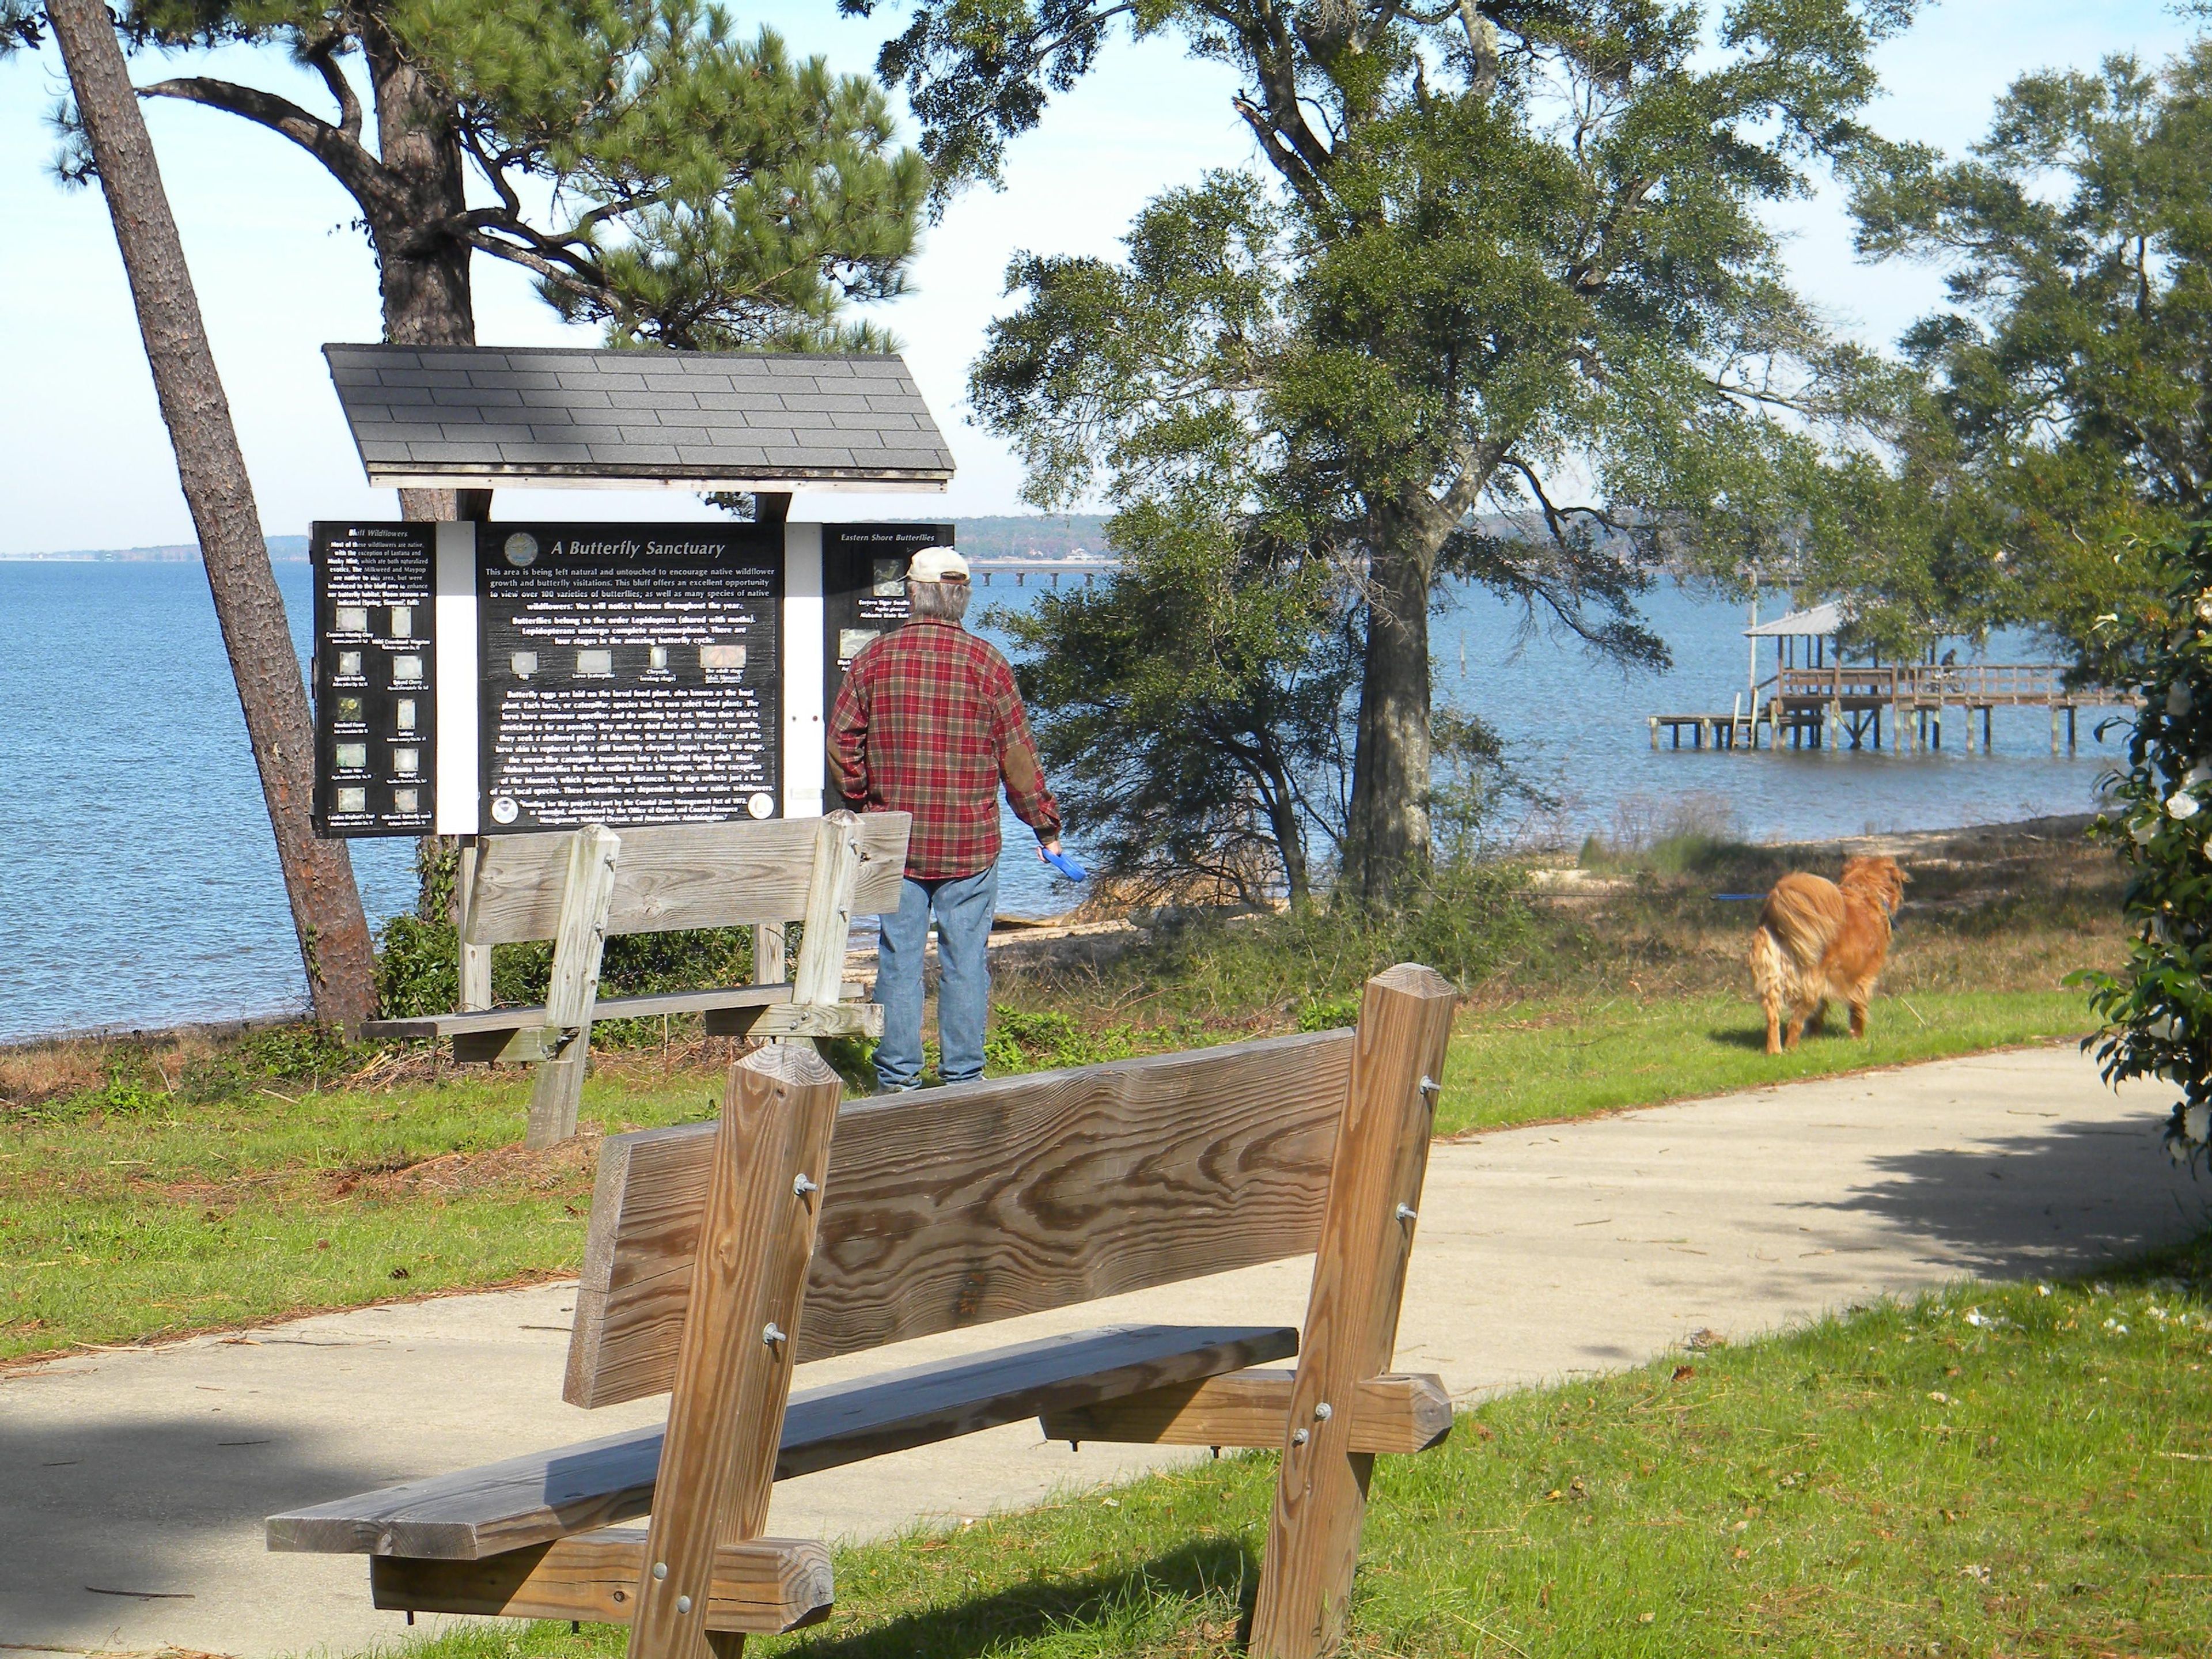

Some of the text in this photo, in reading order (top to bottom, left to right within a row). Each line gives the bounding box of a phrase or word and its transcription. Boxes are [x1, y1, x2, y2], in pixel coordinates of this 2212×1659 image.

[551, 541, 562, 554] A
[569, 540, 640, 558] Butterfly
[646, 541, 725, 558] Sanctuary
[532, 568, 552, 577] being
[490, 579, 517, 588] growth
[537, 579, 570, 588] butterfly
[725, 578, 769, 587] opportunity
[601, 590, 642, 598] butterflies;
[512, 616, 551, 624] Butterflies
[554, 616, 580, 626] belong
[593, 616, 605, 624] the
[631, 616, 676, 625] Lepidoptera
[678, 615, 706, 624] (shared
